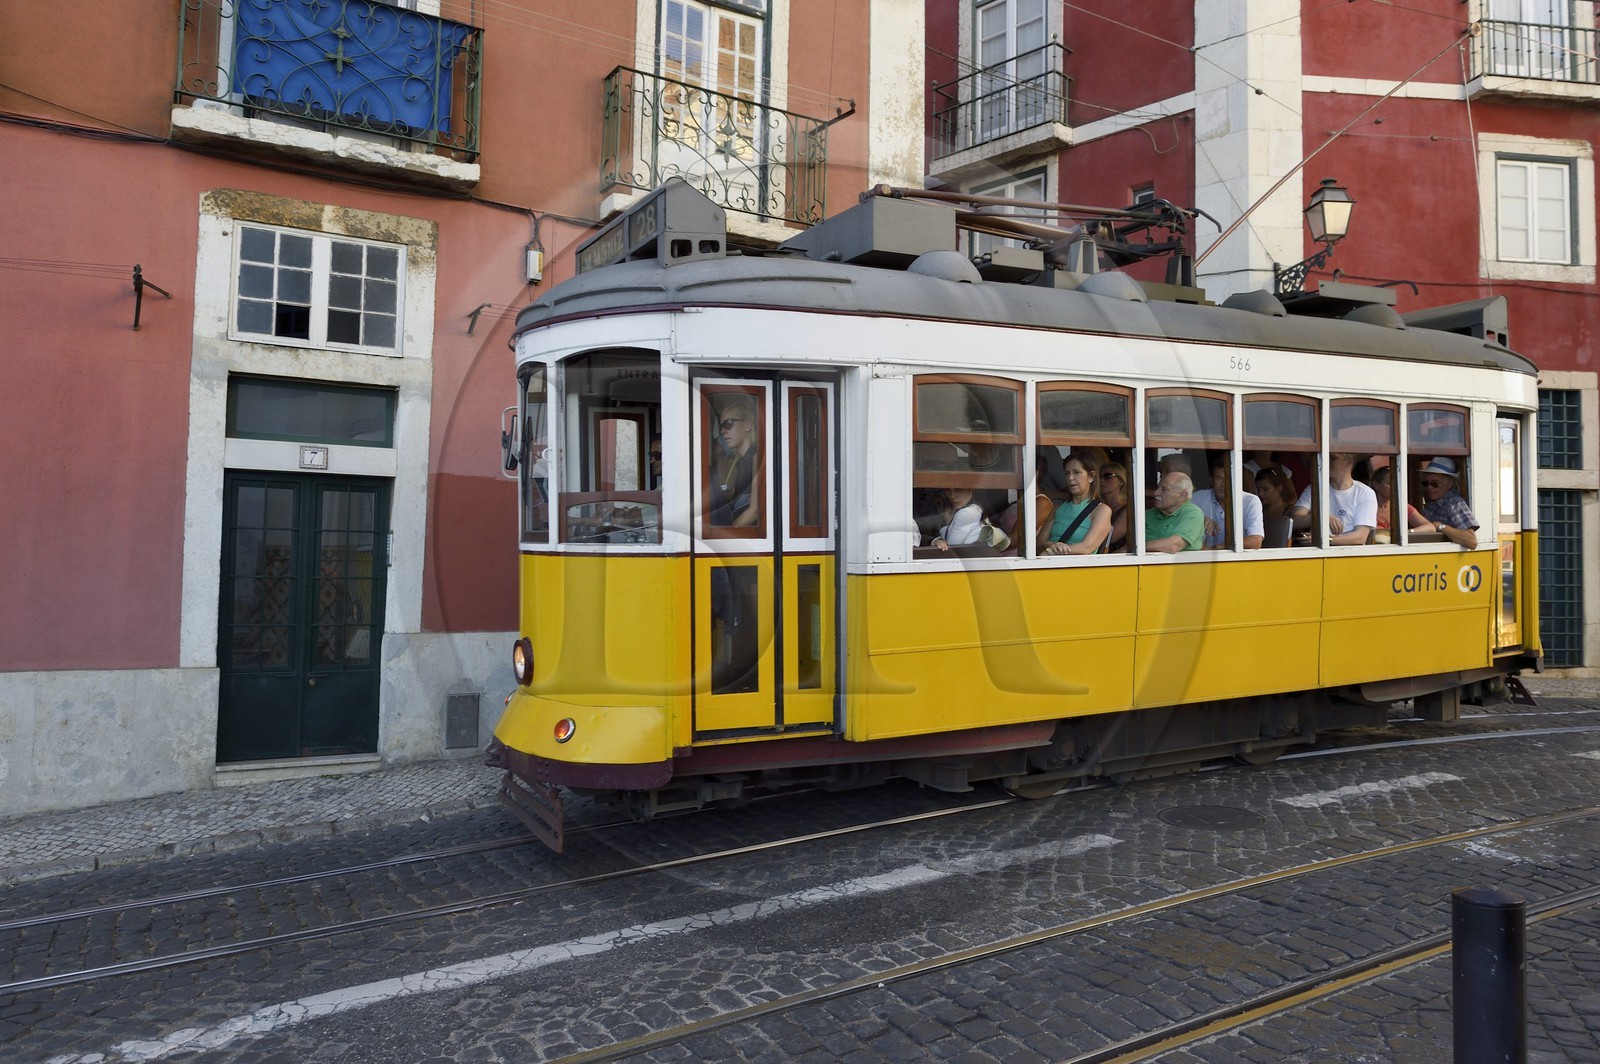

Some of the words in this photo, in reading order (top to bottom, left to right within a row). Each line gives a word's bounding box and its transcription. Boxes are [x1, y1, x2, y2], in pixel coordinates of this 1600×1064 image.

[637, 204, 656, 242] 28
[1229, 356, 1251, 371] 566
[310, 452, 318, 464] 7
[1392, 564, 1448, 594] carris
